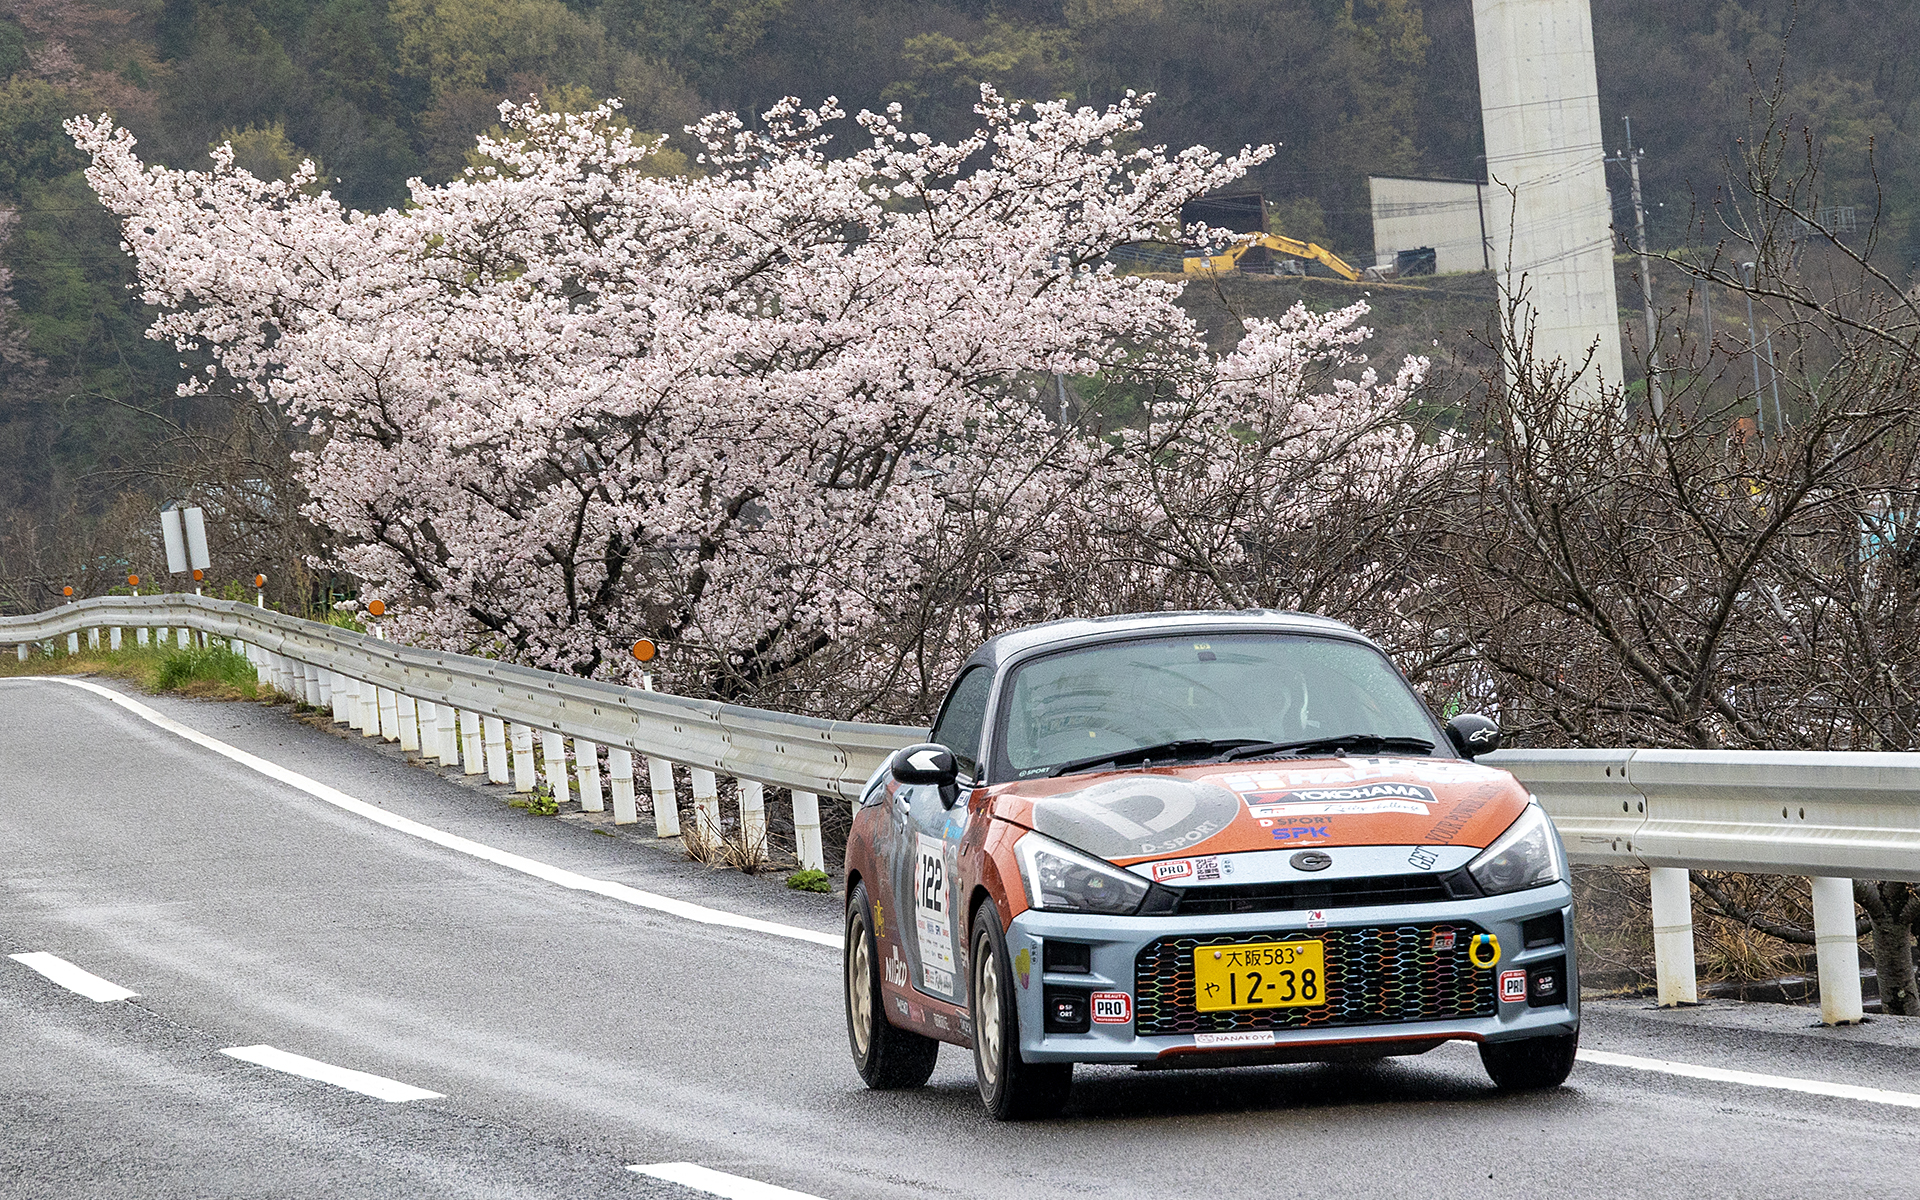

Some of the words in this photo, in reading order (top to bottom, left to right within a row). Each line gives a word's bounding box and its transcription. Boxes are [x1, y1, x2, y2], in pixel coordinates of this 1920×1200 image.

[1291, 785, 1426, 800] YOKOHAMA
[1276, 816, 1333, 826] SPORT
[1141, 820, 1219, 853] D-SPORT
[1271, 826, 1332, 840] SPK
[1425, 820, 1463, 846] YOUR
[1408, 846, 1439, 870] GET
[1160, 865, 1185, 876] PRO
[922, 853, 943, 913] 122
[1226, 948, 1294, 967] 大阪583
[1204, 982, 1220, 998] や
[1229, 968, 1317, 1005] 12-38
[1507, 979, 1524, 993] PRO
[1097, 1001, 1122, 1015] PRO
[1216, 1034, 1273, 1042] NANAKOYA
